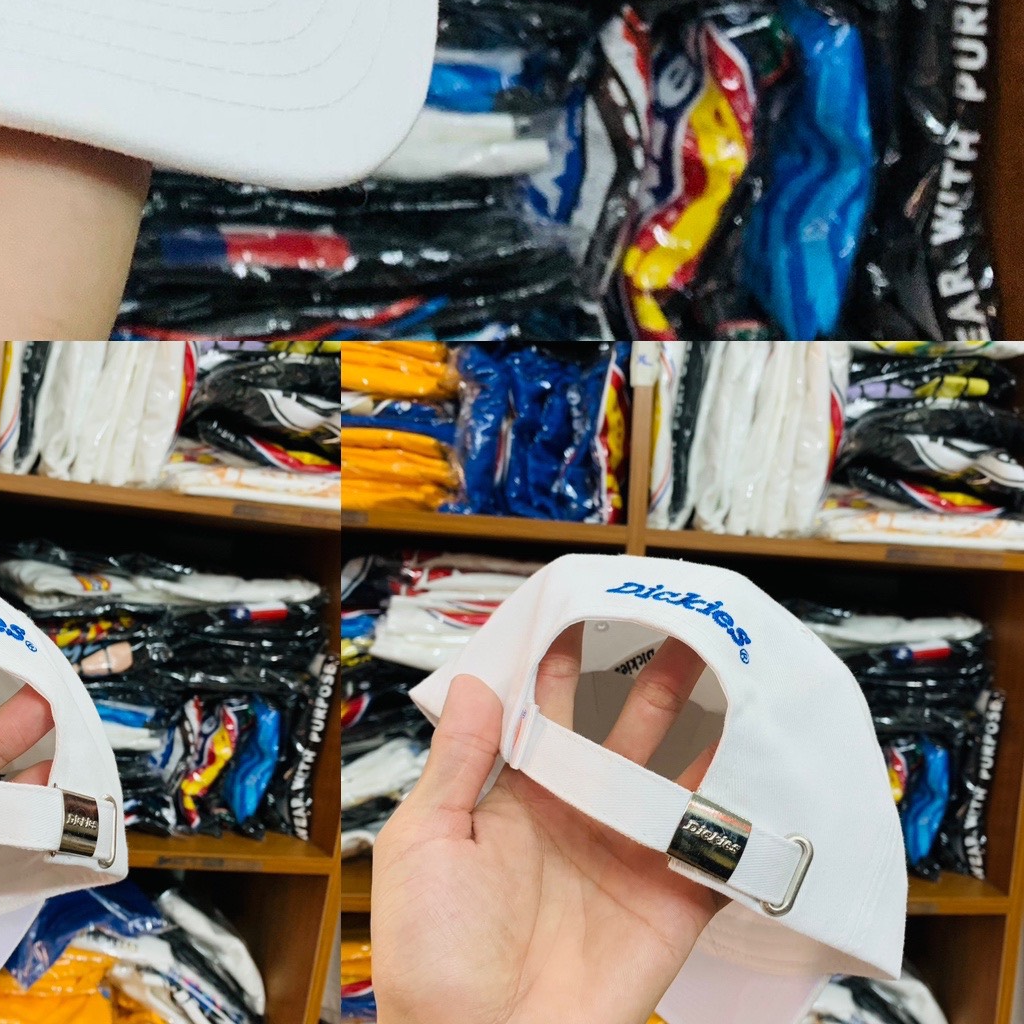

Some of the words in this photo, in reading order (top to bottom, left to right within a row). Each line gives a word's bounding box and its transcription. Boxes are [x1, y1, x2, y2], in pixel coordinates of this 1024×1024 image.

[930, 129, 981, 246] WITH
[606, 582, 752, 646] Dickies
[682, 819, 741, 854] Dickies
